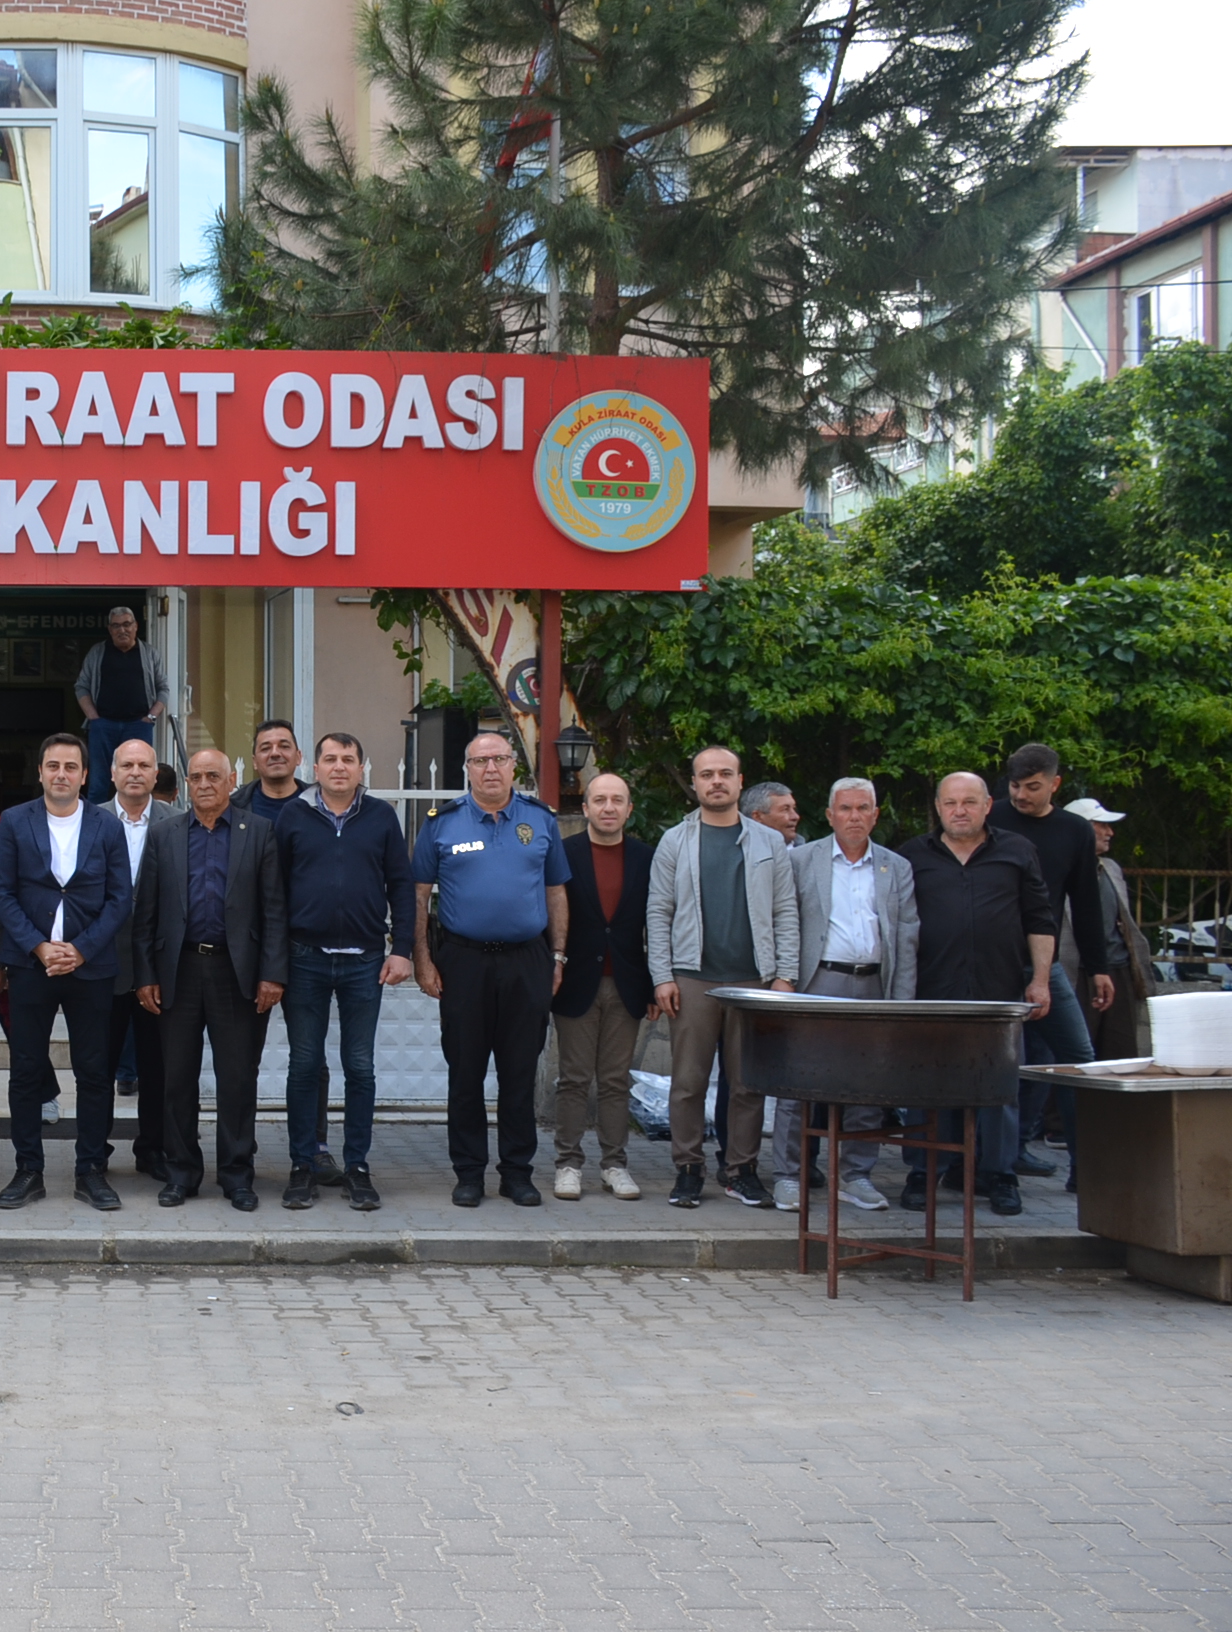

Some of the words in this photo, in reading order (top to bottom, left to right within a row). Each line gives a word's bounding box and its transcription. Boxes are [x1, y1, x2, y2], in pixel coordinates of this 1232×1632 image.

[263, 372, 523, 450] ODASI
[568, 415, 595, 437] KULA
[597, 408, 637, 421] ZİRAAT
[639, 416, 667, 443] ODASI
[571, 441, 591, 477] VATAN
[641, 442, 661, 480] EKMEK
[586, 484, 646, 497] TZOB
[599, 502, 631, 514] 1979
